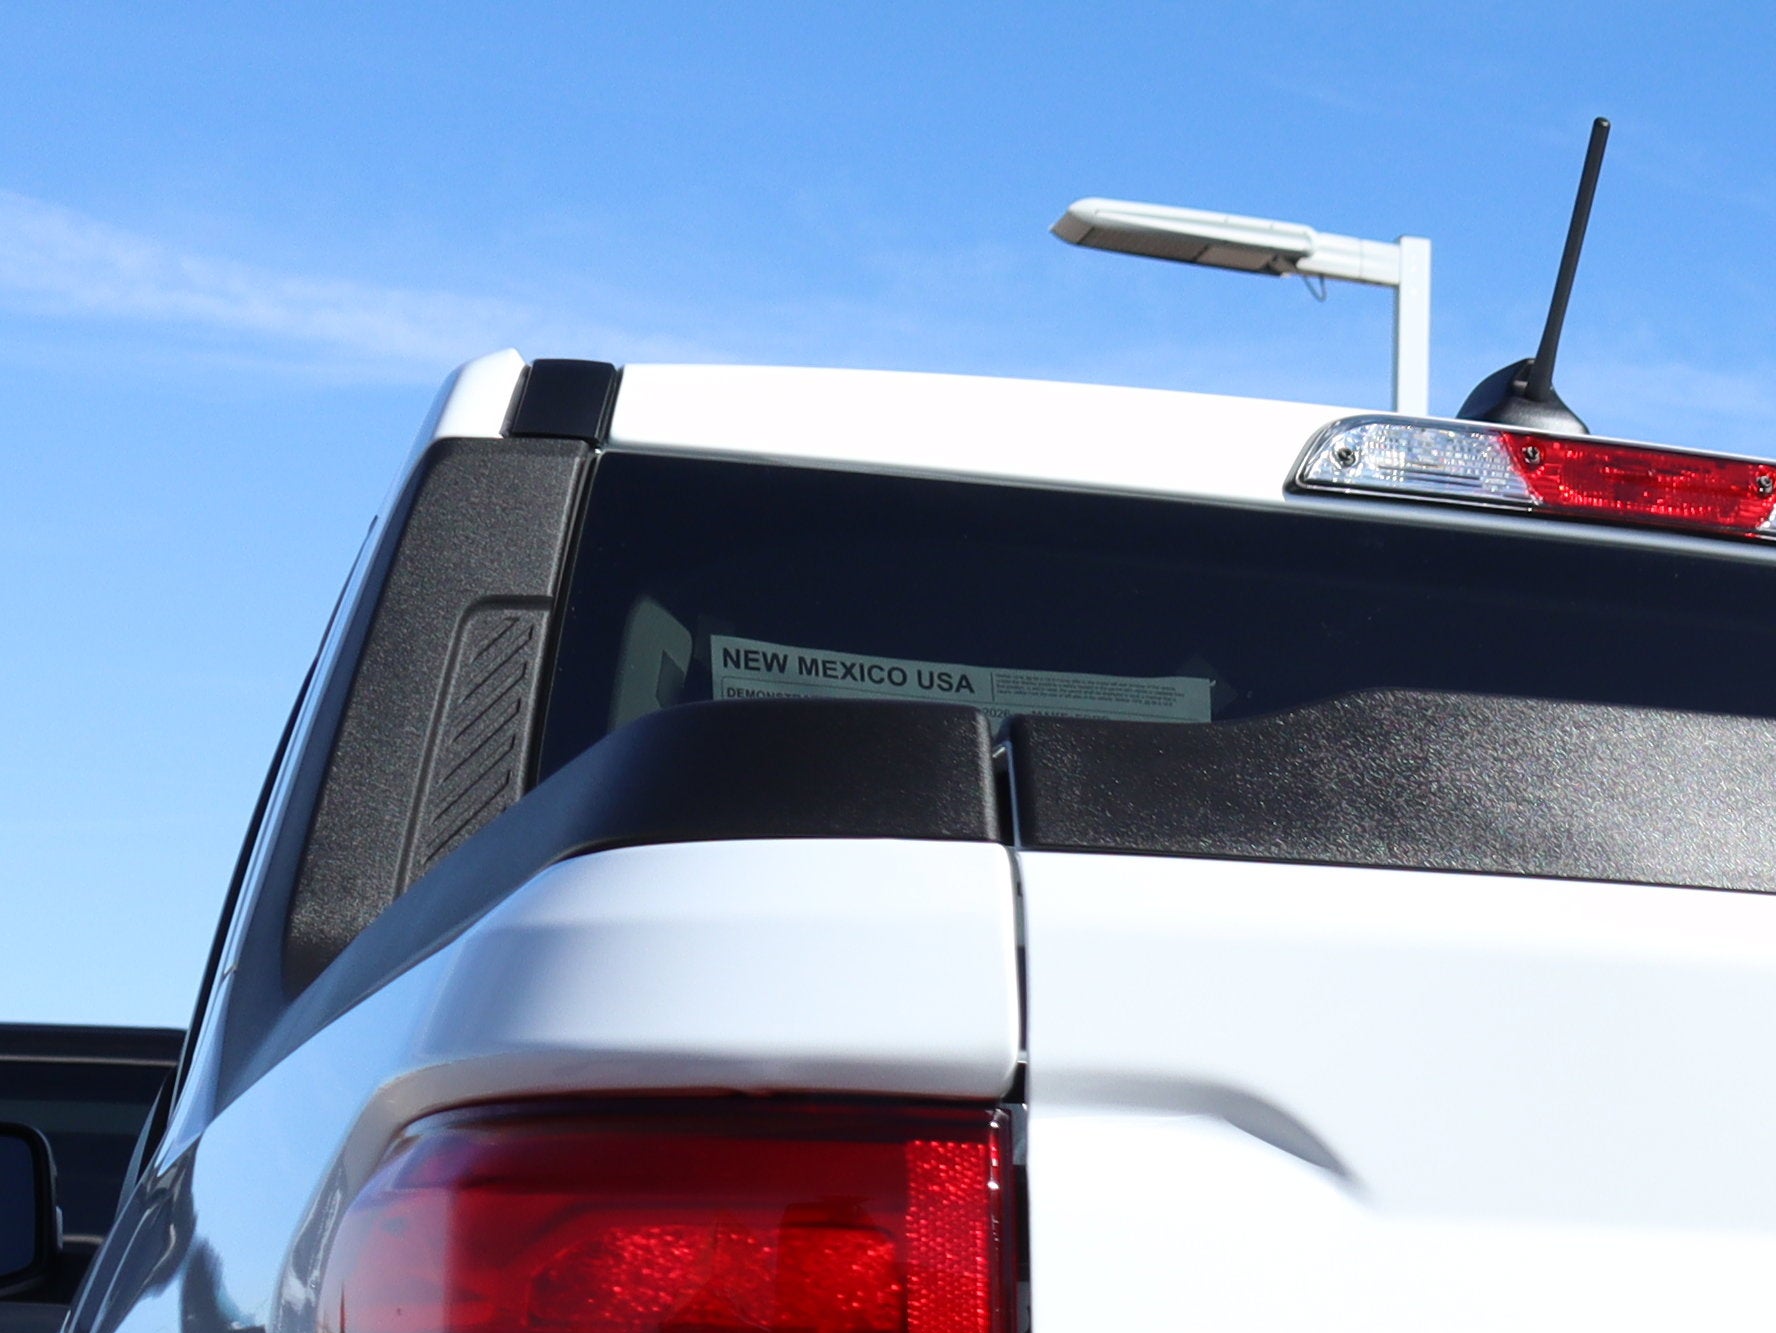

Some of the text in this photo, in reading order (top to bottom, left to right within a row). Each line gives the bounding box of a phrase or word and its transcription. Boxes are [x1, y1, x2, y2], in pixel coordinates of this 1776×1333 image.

[722, 646, 788, 674] NEW
[797, 655, 908, 688] MEXICO
[917, 670, 975, 695] USA
